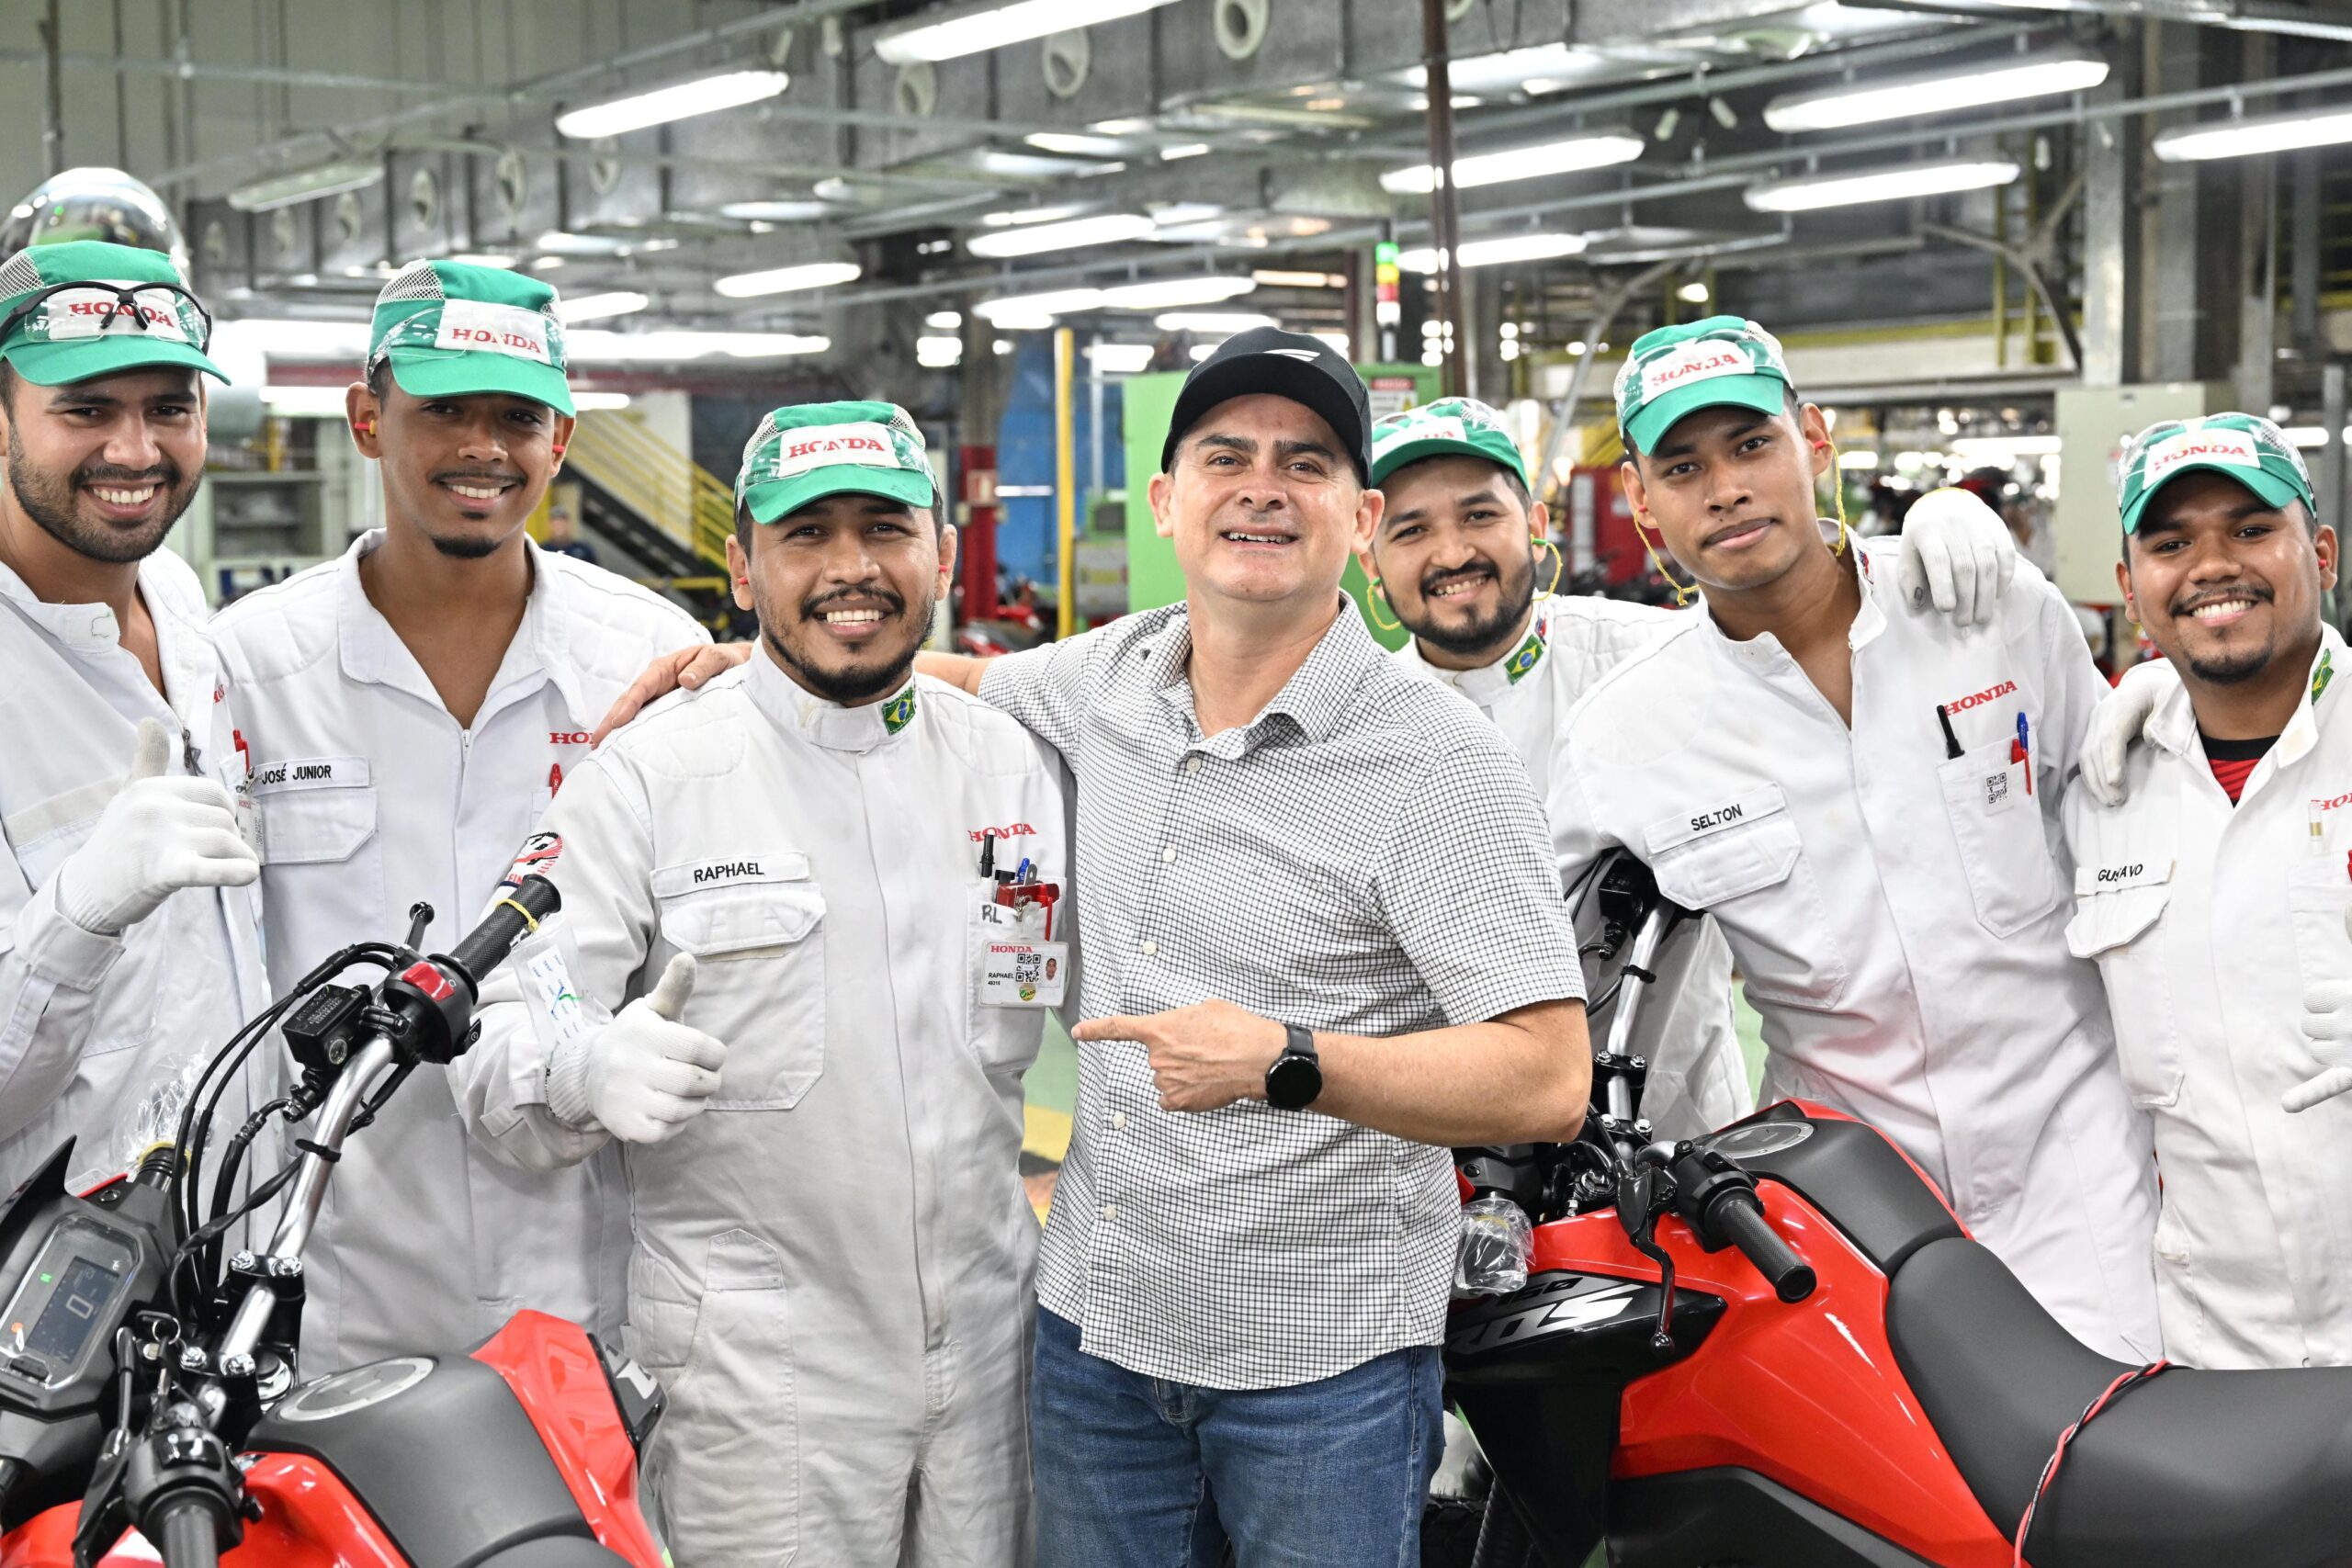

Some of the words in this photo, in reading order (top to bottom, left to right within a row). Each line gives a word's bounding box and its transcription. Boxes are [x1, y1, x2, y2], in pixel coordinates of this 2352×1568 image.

[452, 328, 541, 354] HONDA
[1944, 680, 2018, 716] HONDA
[548, 731, 594, 745] HO
[262, 762, 288, 785] JOSÉ
[292, 765, 332, 781] JUNIOR
[1690, 804, 1743, 831] SELTON
[967, 823, 1037, 843] HONDA
[694, 862, 765, 884] RAPHAEL
[981, 904, 1003, 925] RL
[990, 945, 1034, 953] HONDA
